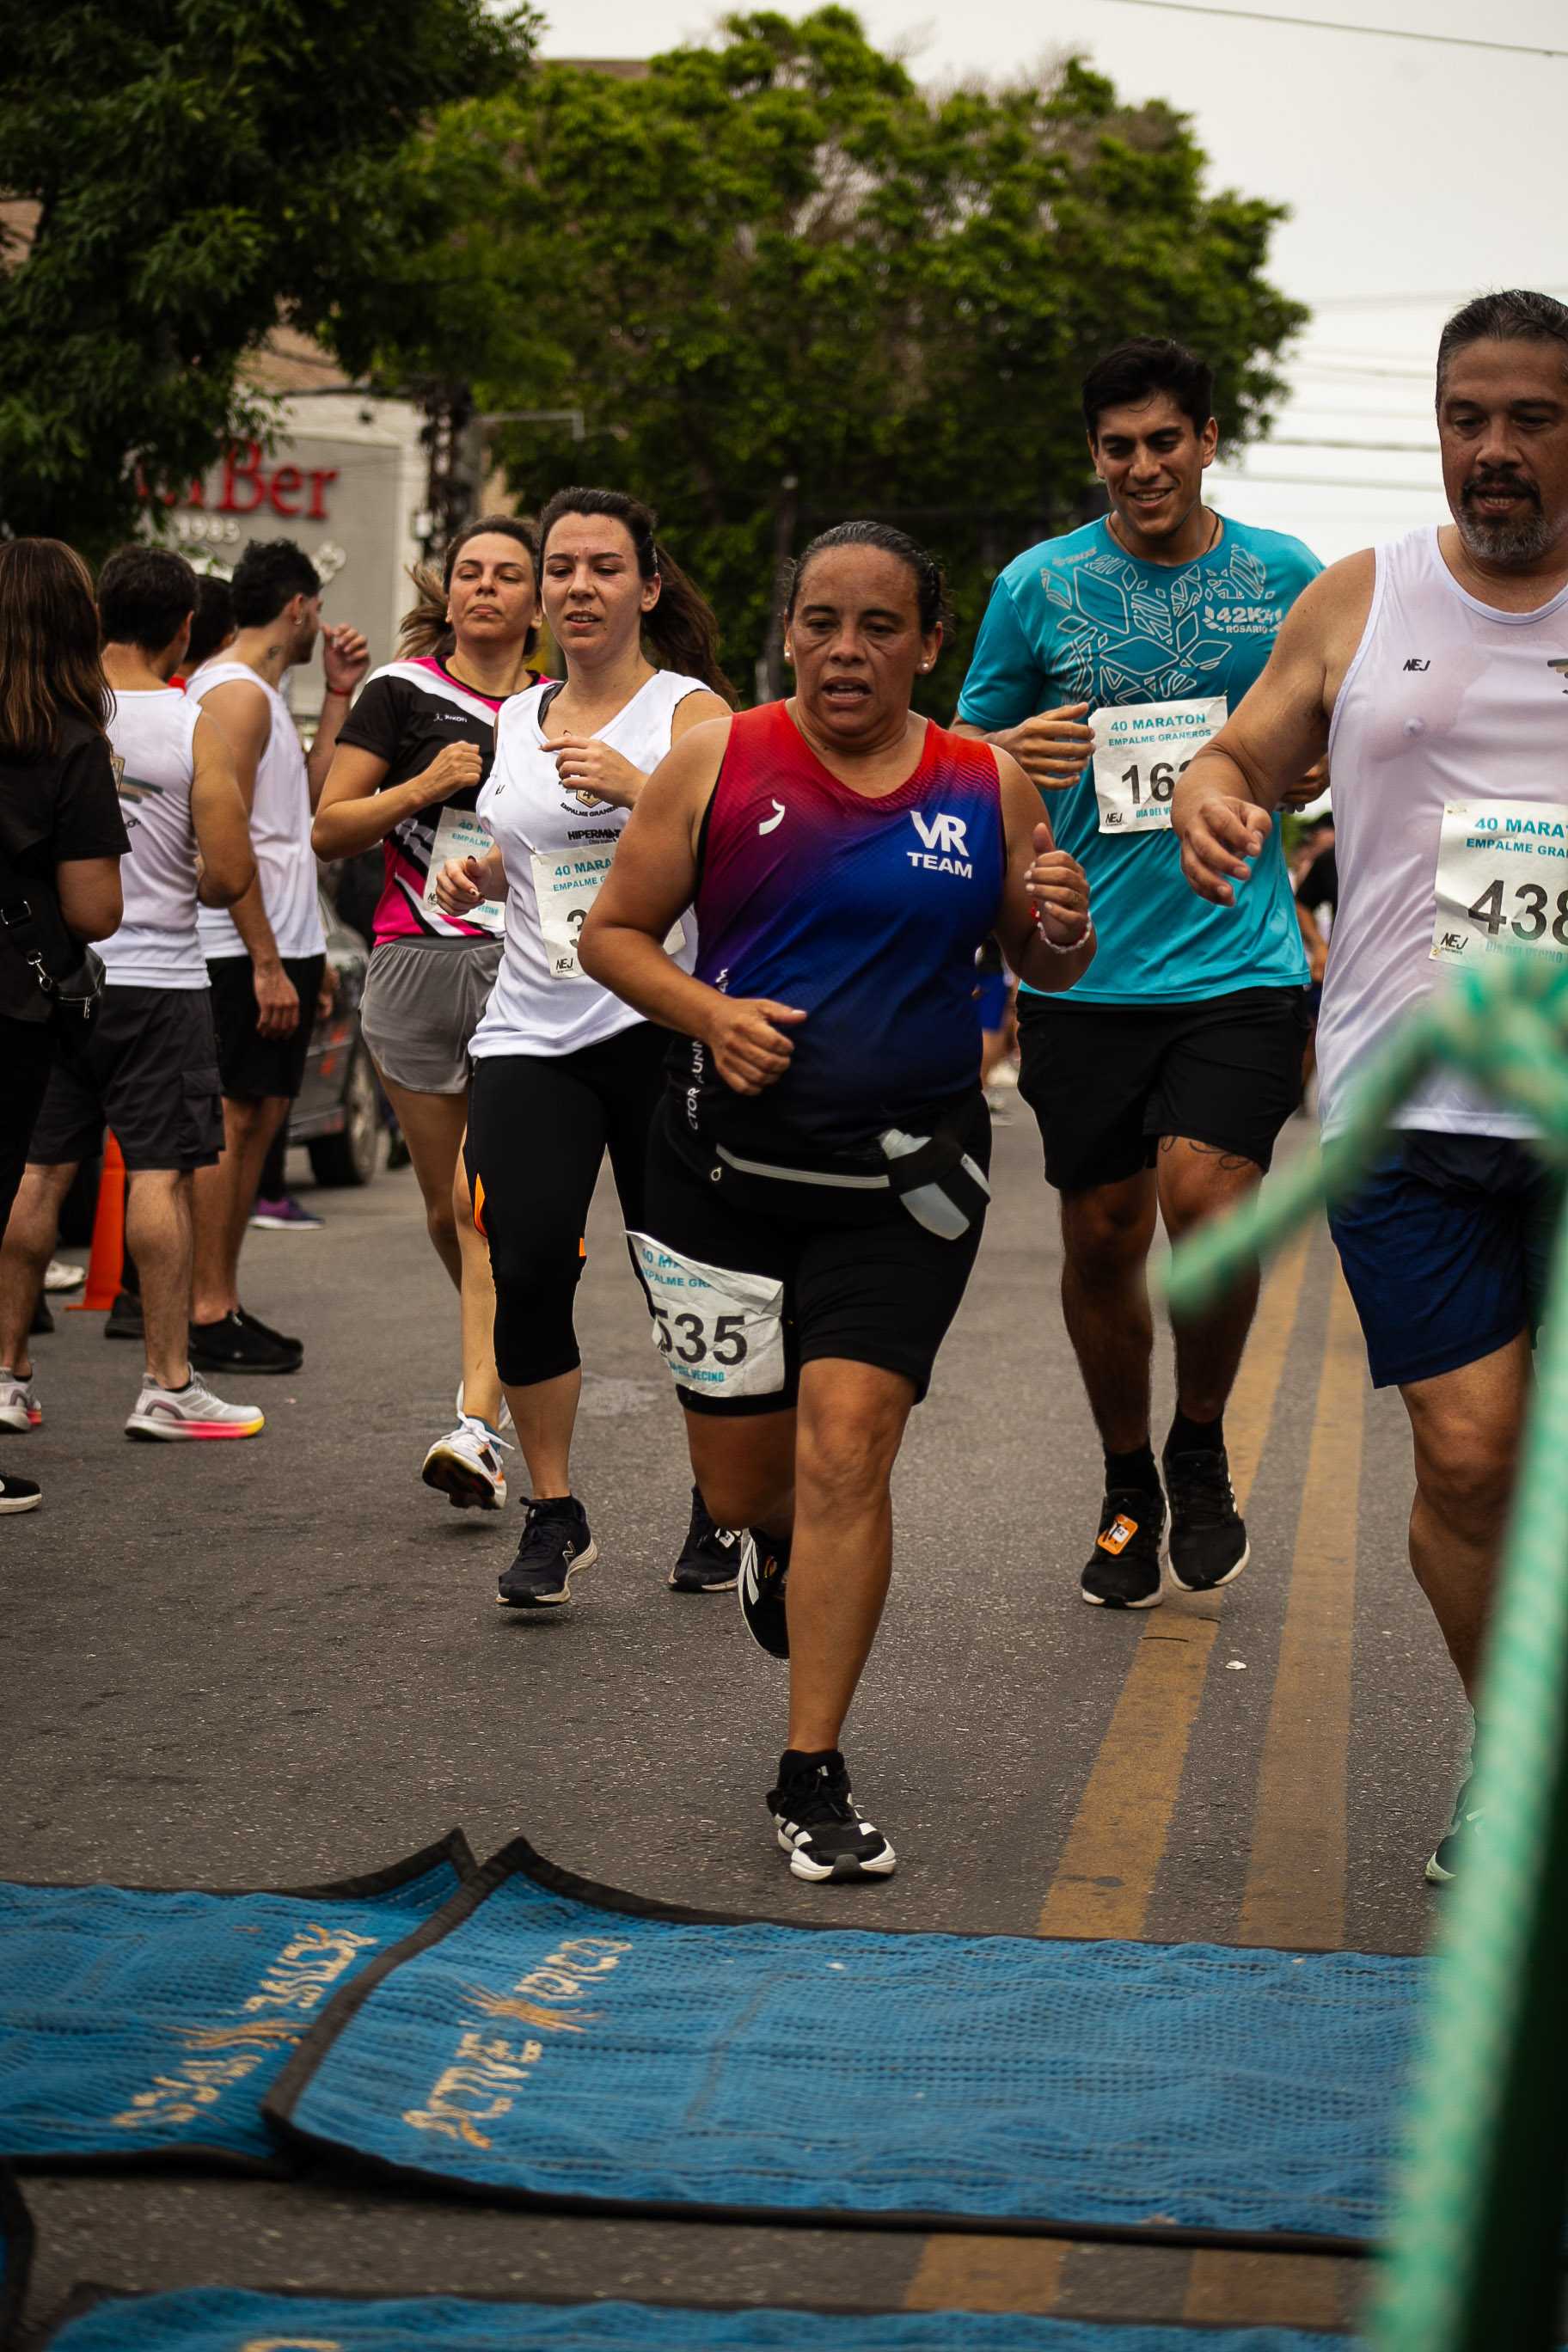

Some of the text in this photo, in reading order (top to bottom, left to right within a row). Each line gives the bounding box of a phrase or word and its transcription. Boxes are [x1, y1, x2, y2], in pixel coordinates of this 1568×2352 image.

[1226, 625, 1267, 634] ROSARIO
[1403, 658, 1431, 671] NEJ
[1111, 713, 1206, 732] 40 MARATON
[1109, 729, 1211, 746] EMPALME GRANEROS
[1122, 760, 1192, 805] 16
[560, 802, 619, 818] EMPALME GRANER
[1106, 812, 1124, 824] NEJ
[1136, 809, 1148, 818] DIA
[1149, 808, 1161, 818] DEL
[458, 821, 473, 831] 40
[910, 810, 970, 857] VR
[1474, 818, 1568, 839] 40 MARA
[451, 832, 491, 848] EMPALME
[1466, 838, 1568, 859] EMPALME GRA
[554, 858, 615, 877] 40 MARA
[907, 851, 973, 879] TEAM
[553, 877, 598, 892] EMPALME
[427, 892, 438, 903] NE
[1441, 933, 1468, 950] NEJ
[555, 958, 574, 971] NEJ
[643, 1267, 684, 1287] MPALME
[690, 1369, 725, 1382] VECINO
